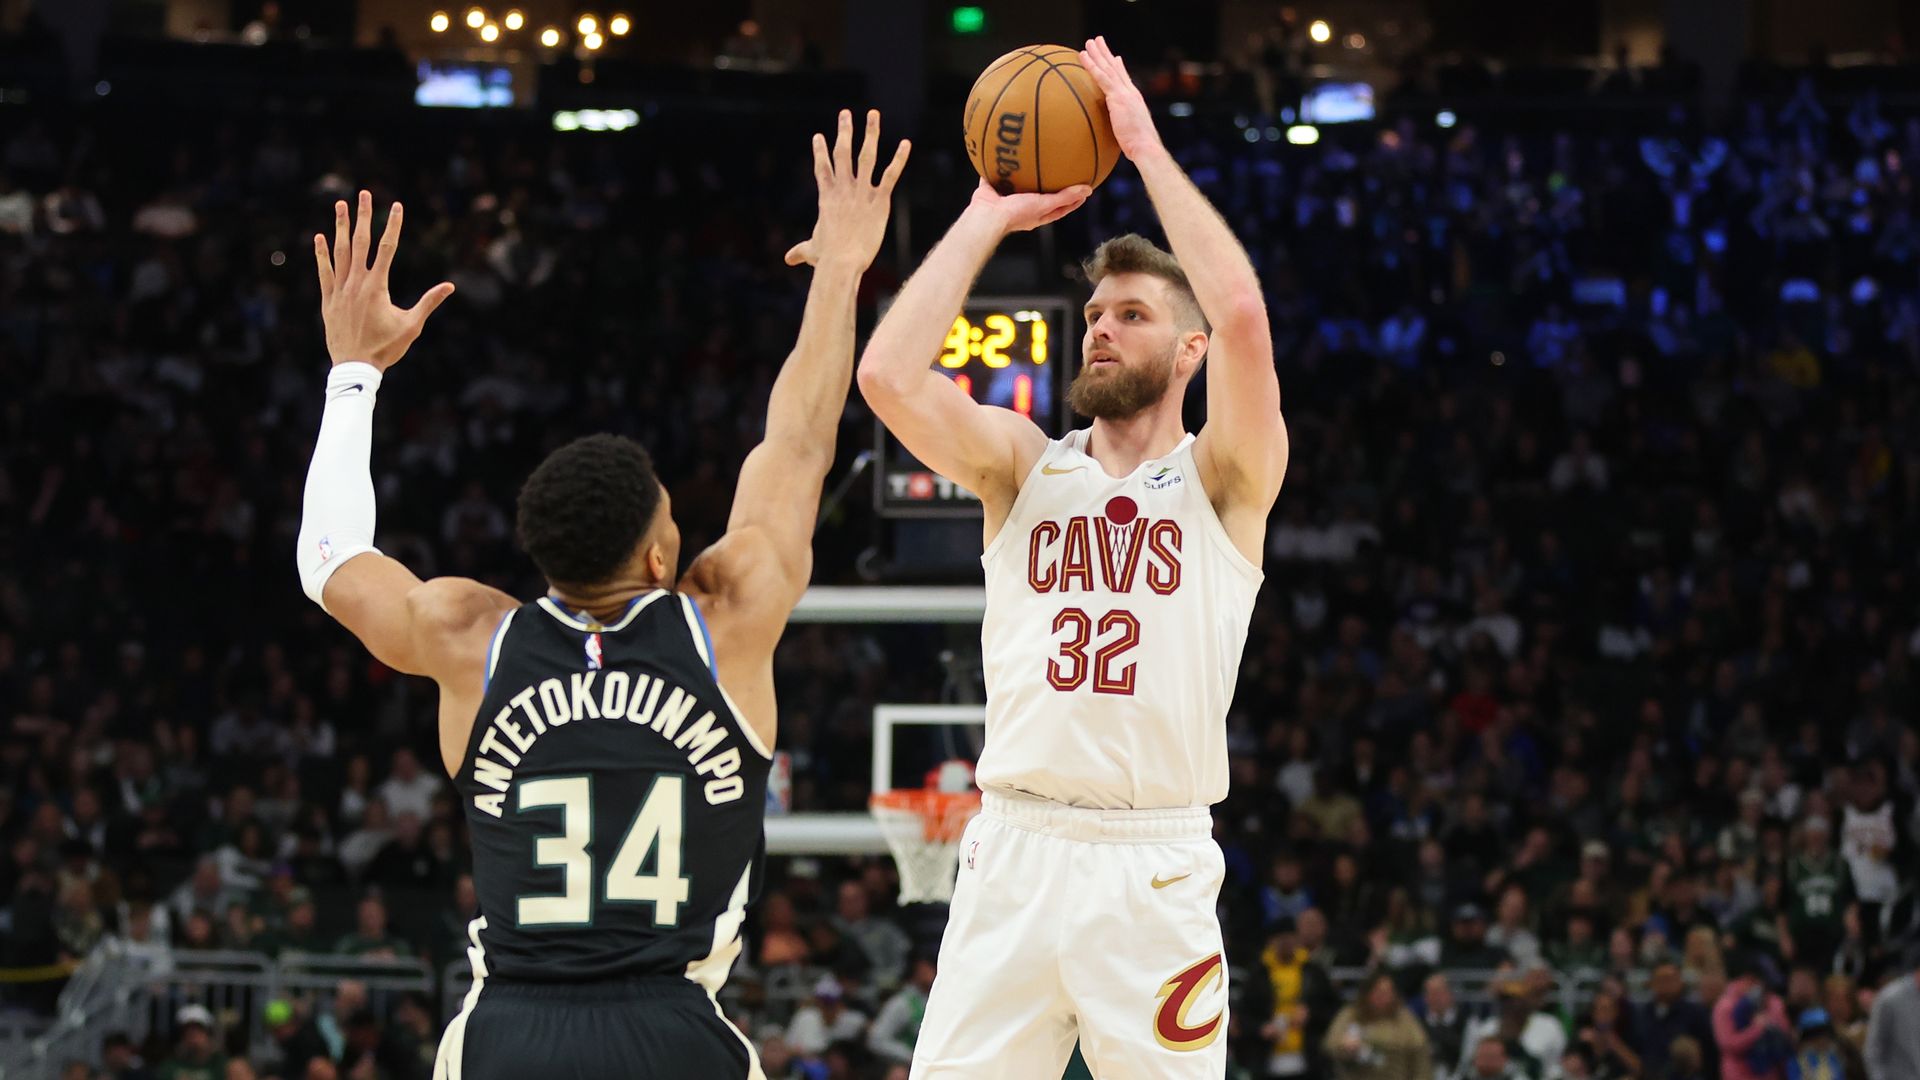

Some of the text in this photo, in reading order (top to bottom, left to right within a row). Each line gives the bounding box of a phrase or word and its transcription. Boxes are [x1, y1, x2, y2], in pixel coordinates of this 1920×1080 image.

[1144, 475, 1182, 490] CLIFFS
[1028, 515, 1182, 596] CAVS
[1046, 607, 1141, 696] 32
[473, 671, 744, 818] ANTETOKOUNMPO
[516, 773, 693, 928] 34
